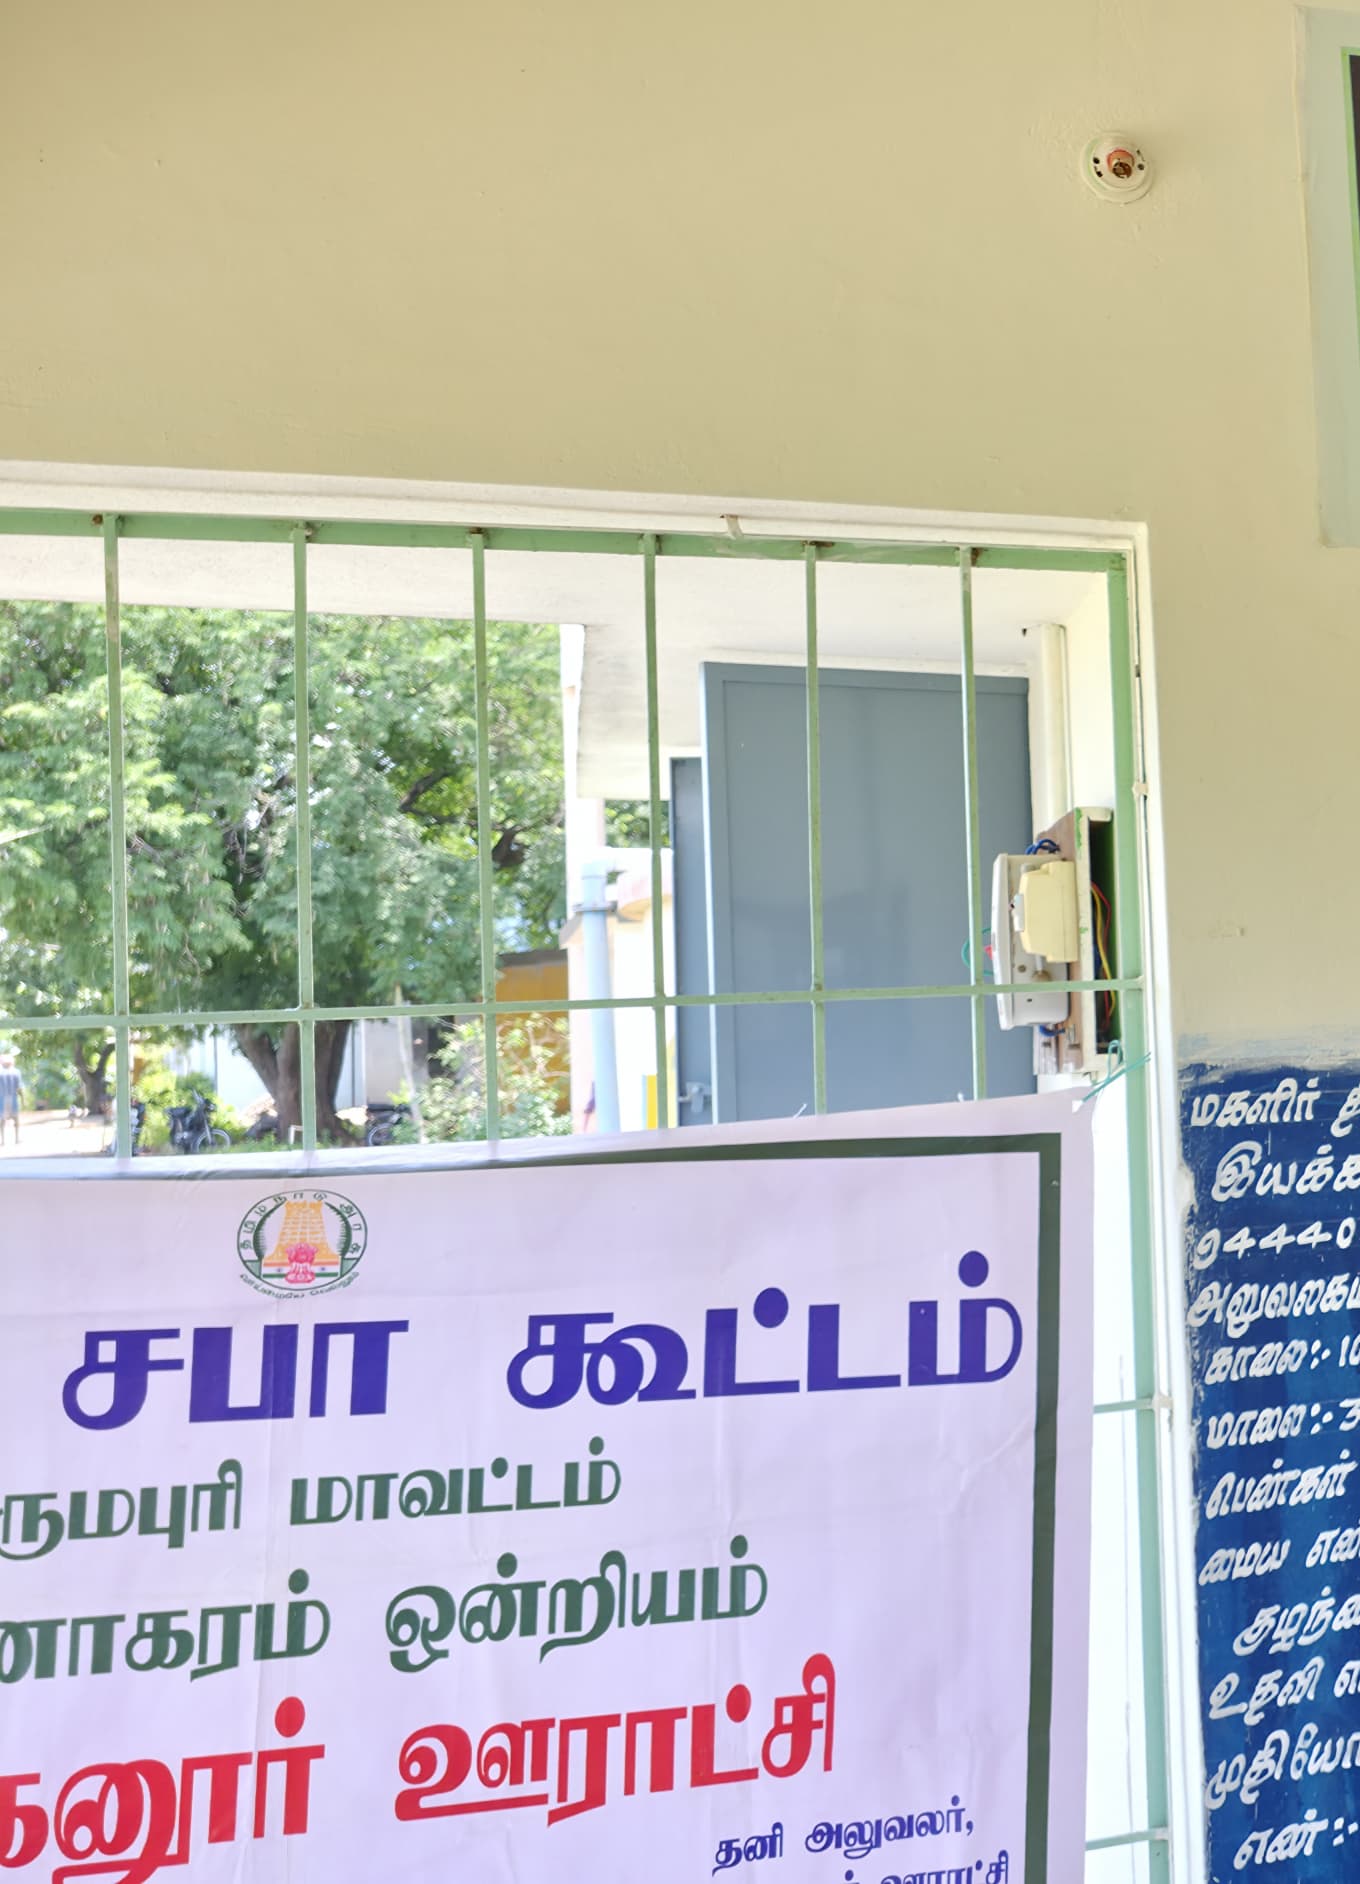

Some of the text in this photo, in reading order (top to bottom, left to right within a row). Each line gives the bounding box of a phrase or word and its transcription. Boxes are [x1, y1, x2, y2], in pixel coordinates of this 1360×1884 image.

[1191, 1076, 1322, 1128] மகளிர்
[61, 1249, 1024, 1432] சபா கூட்டம்
[0, 1436, 622, 1561] ருமபுரி மாவட்டம்
[1204, 1448, 1359, 1520] பெண்கள்
[385, 1534, 769, 1673] ஒன்றியம்
[1198, 1538, 1293, 1587] மைய
[1208, 1655, 1326, 1727] உதவி
[394, 1652, 836, 1827] ஊராட்சி
[711, 1794, 975, 1878] தனி அலுவலர்,
